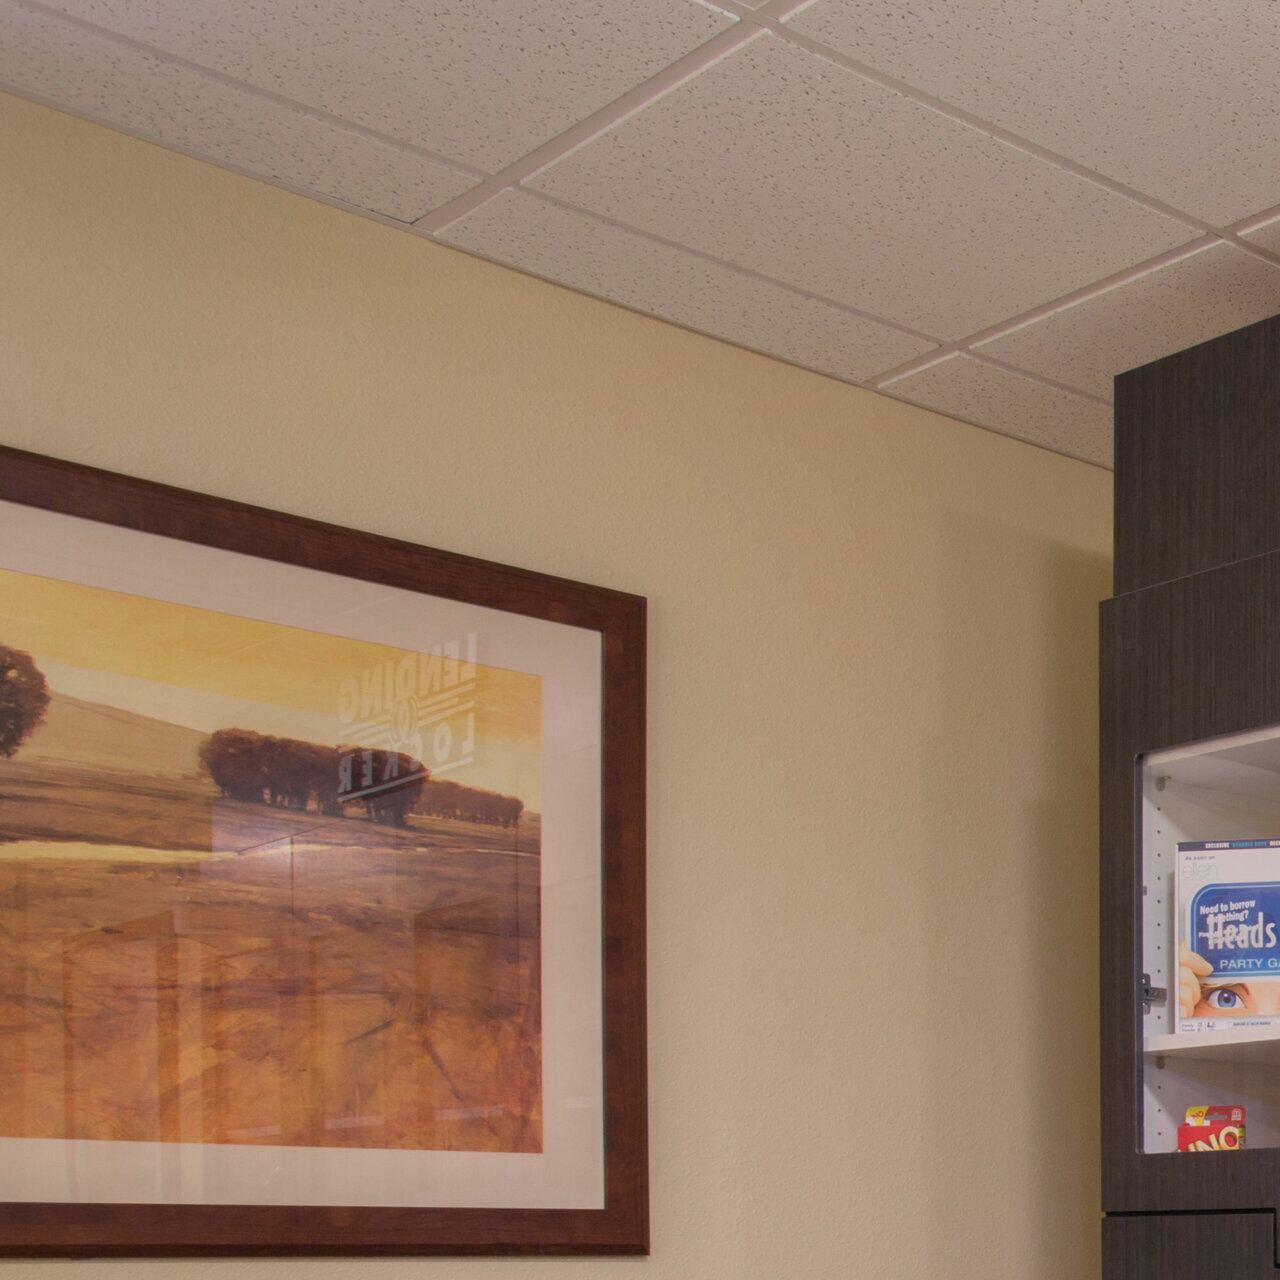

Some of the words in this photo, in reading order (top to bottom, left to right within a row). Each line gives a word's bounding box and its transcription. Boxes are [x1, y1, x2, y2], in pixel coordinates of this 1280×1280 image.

[1200, 903, 1219, 914] Need
[1219, 902, 1229, 912] to
[1229, 900, 1256, 910] borrow
[1208, 911, 1277, 949] Heads
[1219, 958, 1263, 969] PARTY
